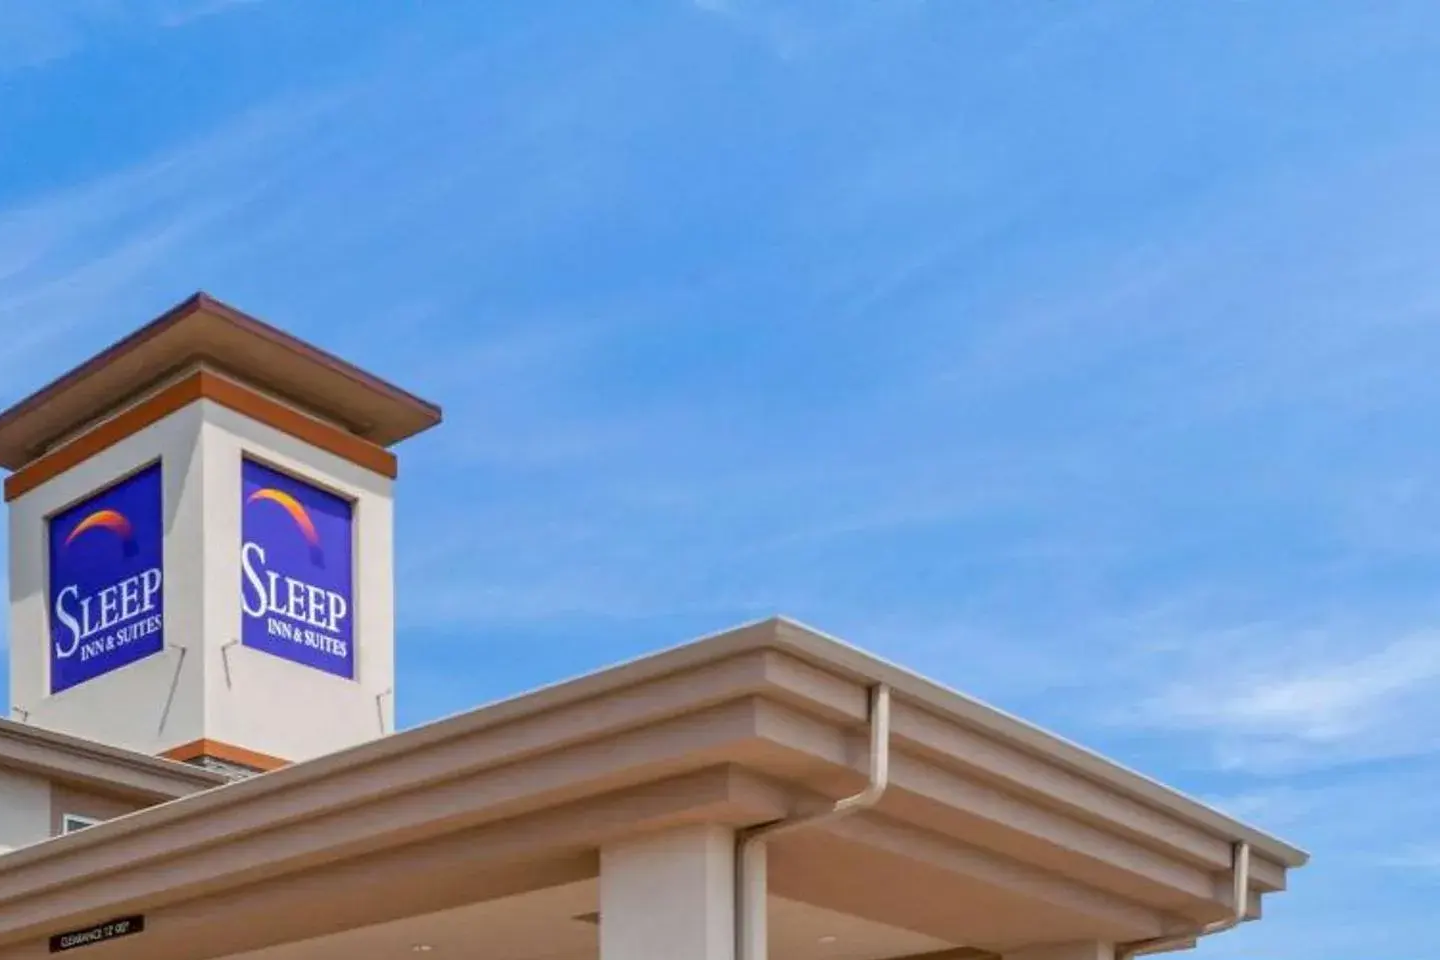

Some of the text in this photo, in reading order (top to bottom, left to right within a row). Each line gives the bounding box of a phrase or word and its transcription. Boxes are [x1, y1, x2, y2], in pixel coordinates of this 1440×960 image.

[56, 568, 161, 659] SLEEP
[240, 542, 347, 634] SLEEP
[81, 614, 162, 661] INN & SUITES
[268, 618, 347, 658] INN & SUITES
